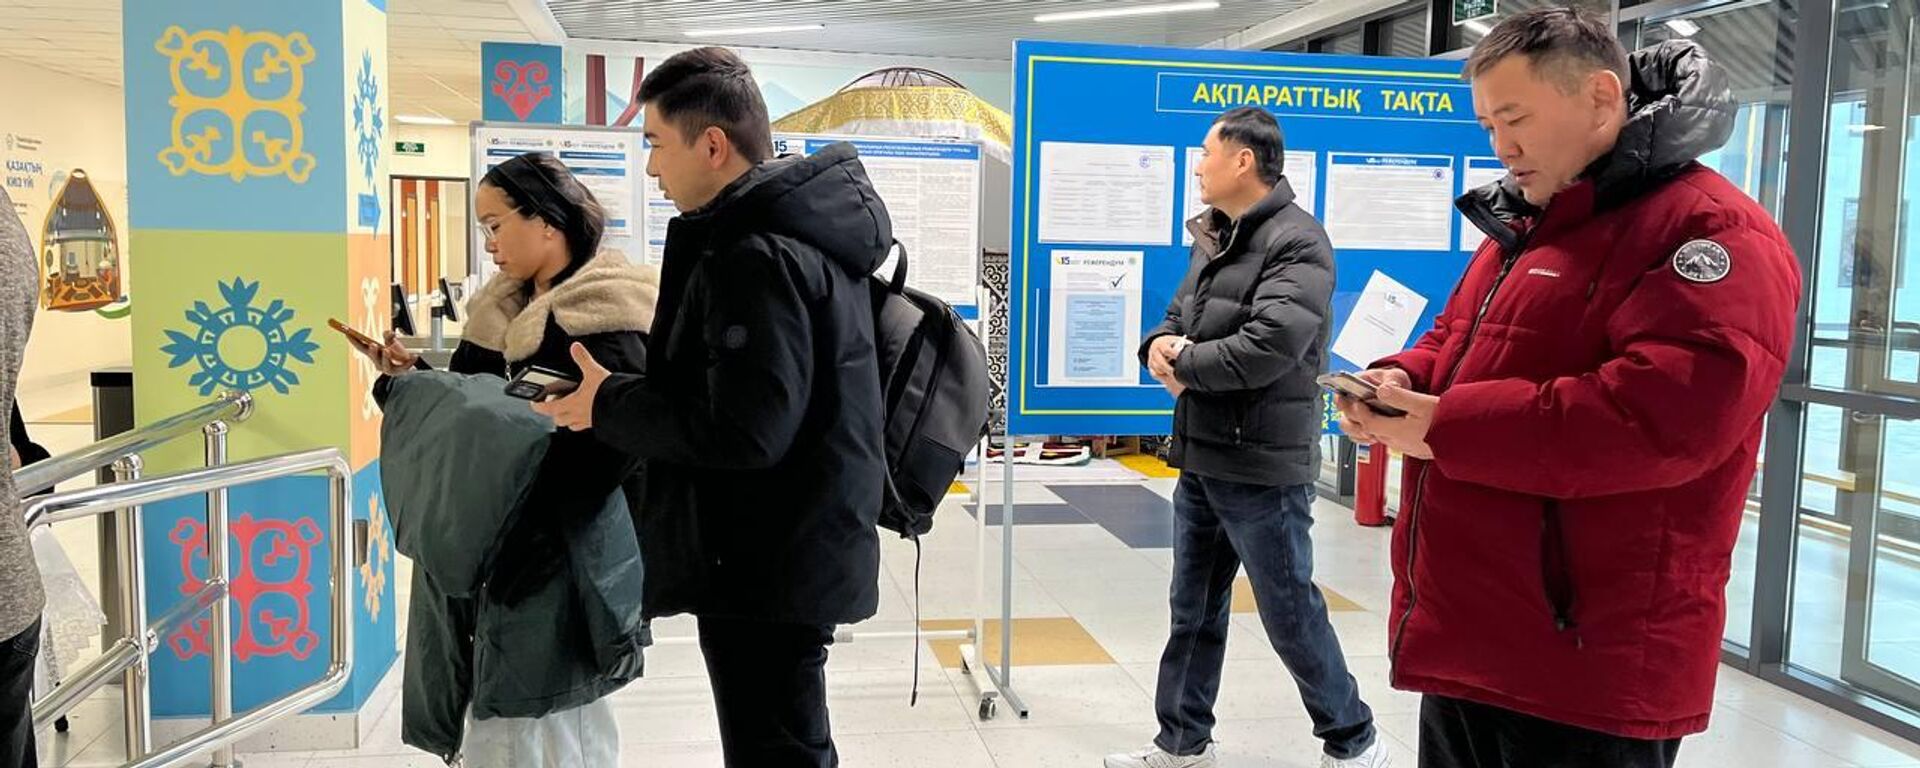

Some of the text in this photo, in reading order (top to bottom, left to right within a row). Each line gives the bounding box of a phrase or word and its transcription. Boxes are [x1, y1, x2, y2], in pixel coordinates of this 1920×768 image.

[1192, 83, 1454, 115] АҚПАРАТТЫҚ ТАҚТА
[774, 140, 788, 152] 15
